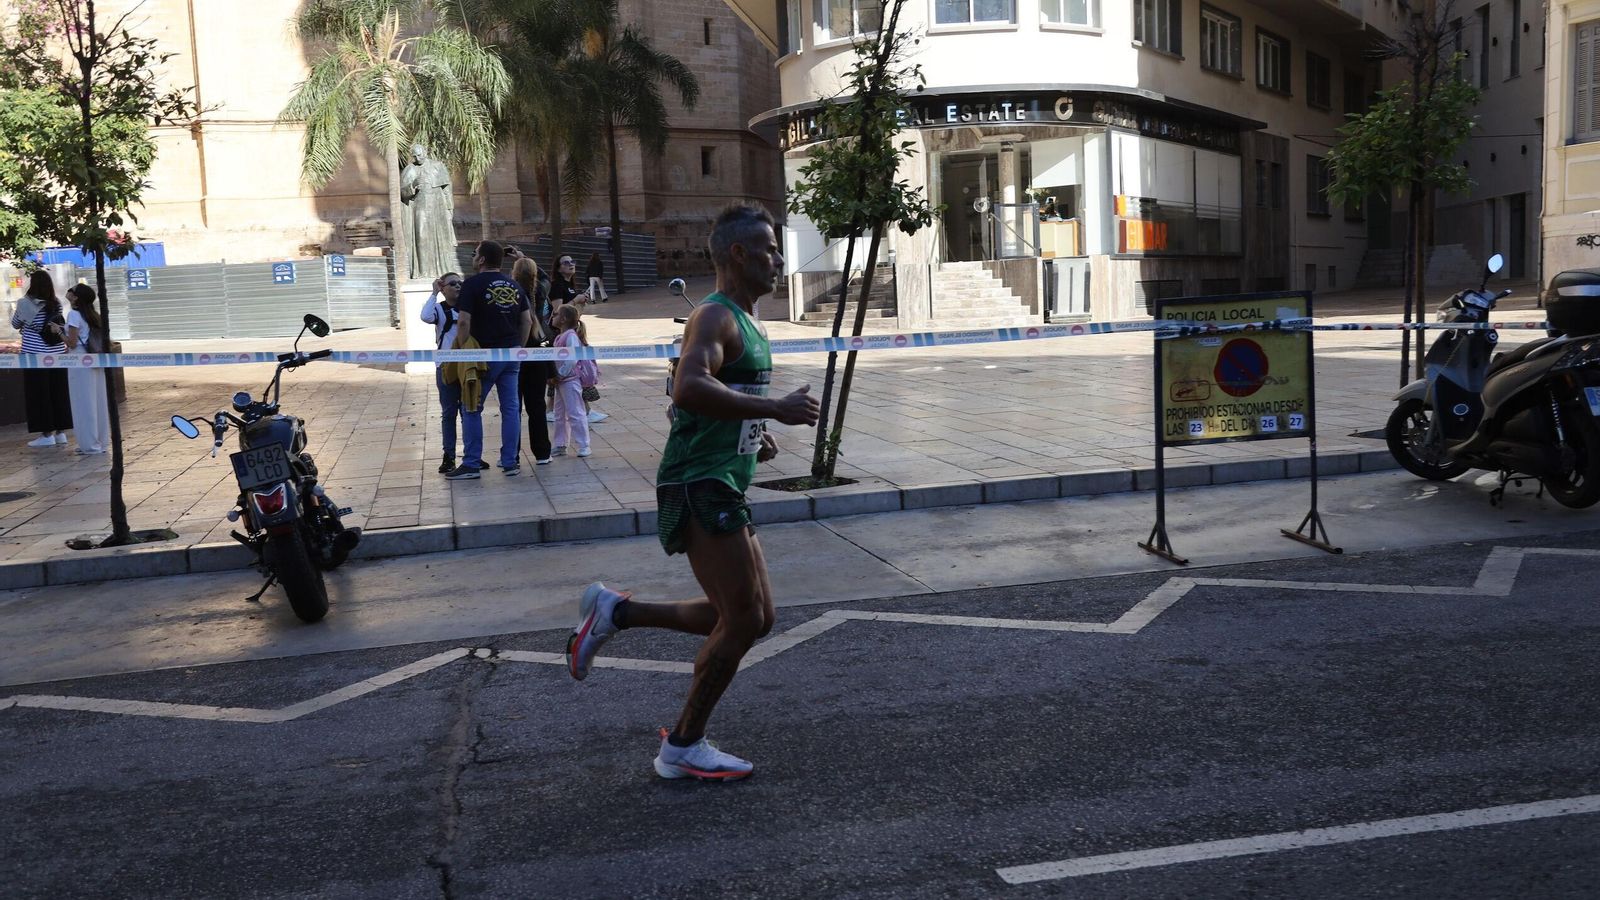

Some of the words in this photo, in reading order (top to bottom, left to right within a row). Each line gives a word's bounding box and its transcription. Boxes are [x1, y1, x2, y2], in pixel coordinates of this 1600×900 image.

[946, 103, 1026, 123] ESTATE
[1223, 308, 1265, 321] LOCAL
[1166, 405, 1215, 421] PROHIBIDO
[1216, 401, 1272, 417] ESTACIONAR
[1273, 399, 1304, 414] DESDE
[1166, 422, 1184, 436] LAS
[1190, 423, 1203, 433] 23
[1221, 419, 1239, 432] DEL
[1262, 418, 1274, 428] 26
[1289, 417, 1302, 426] 27
[246, 447, 283, 468] 6492
[253, 463, 283, 482] LCD
